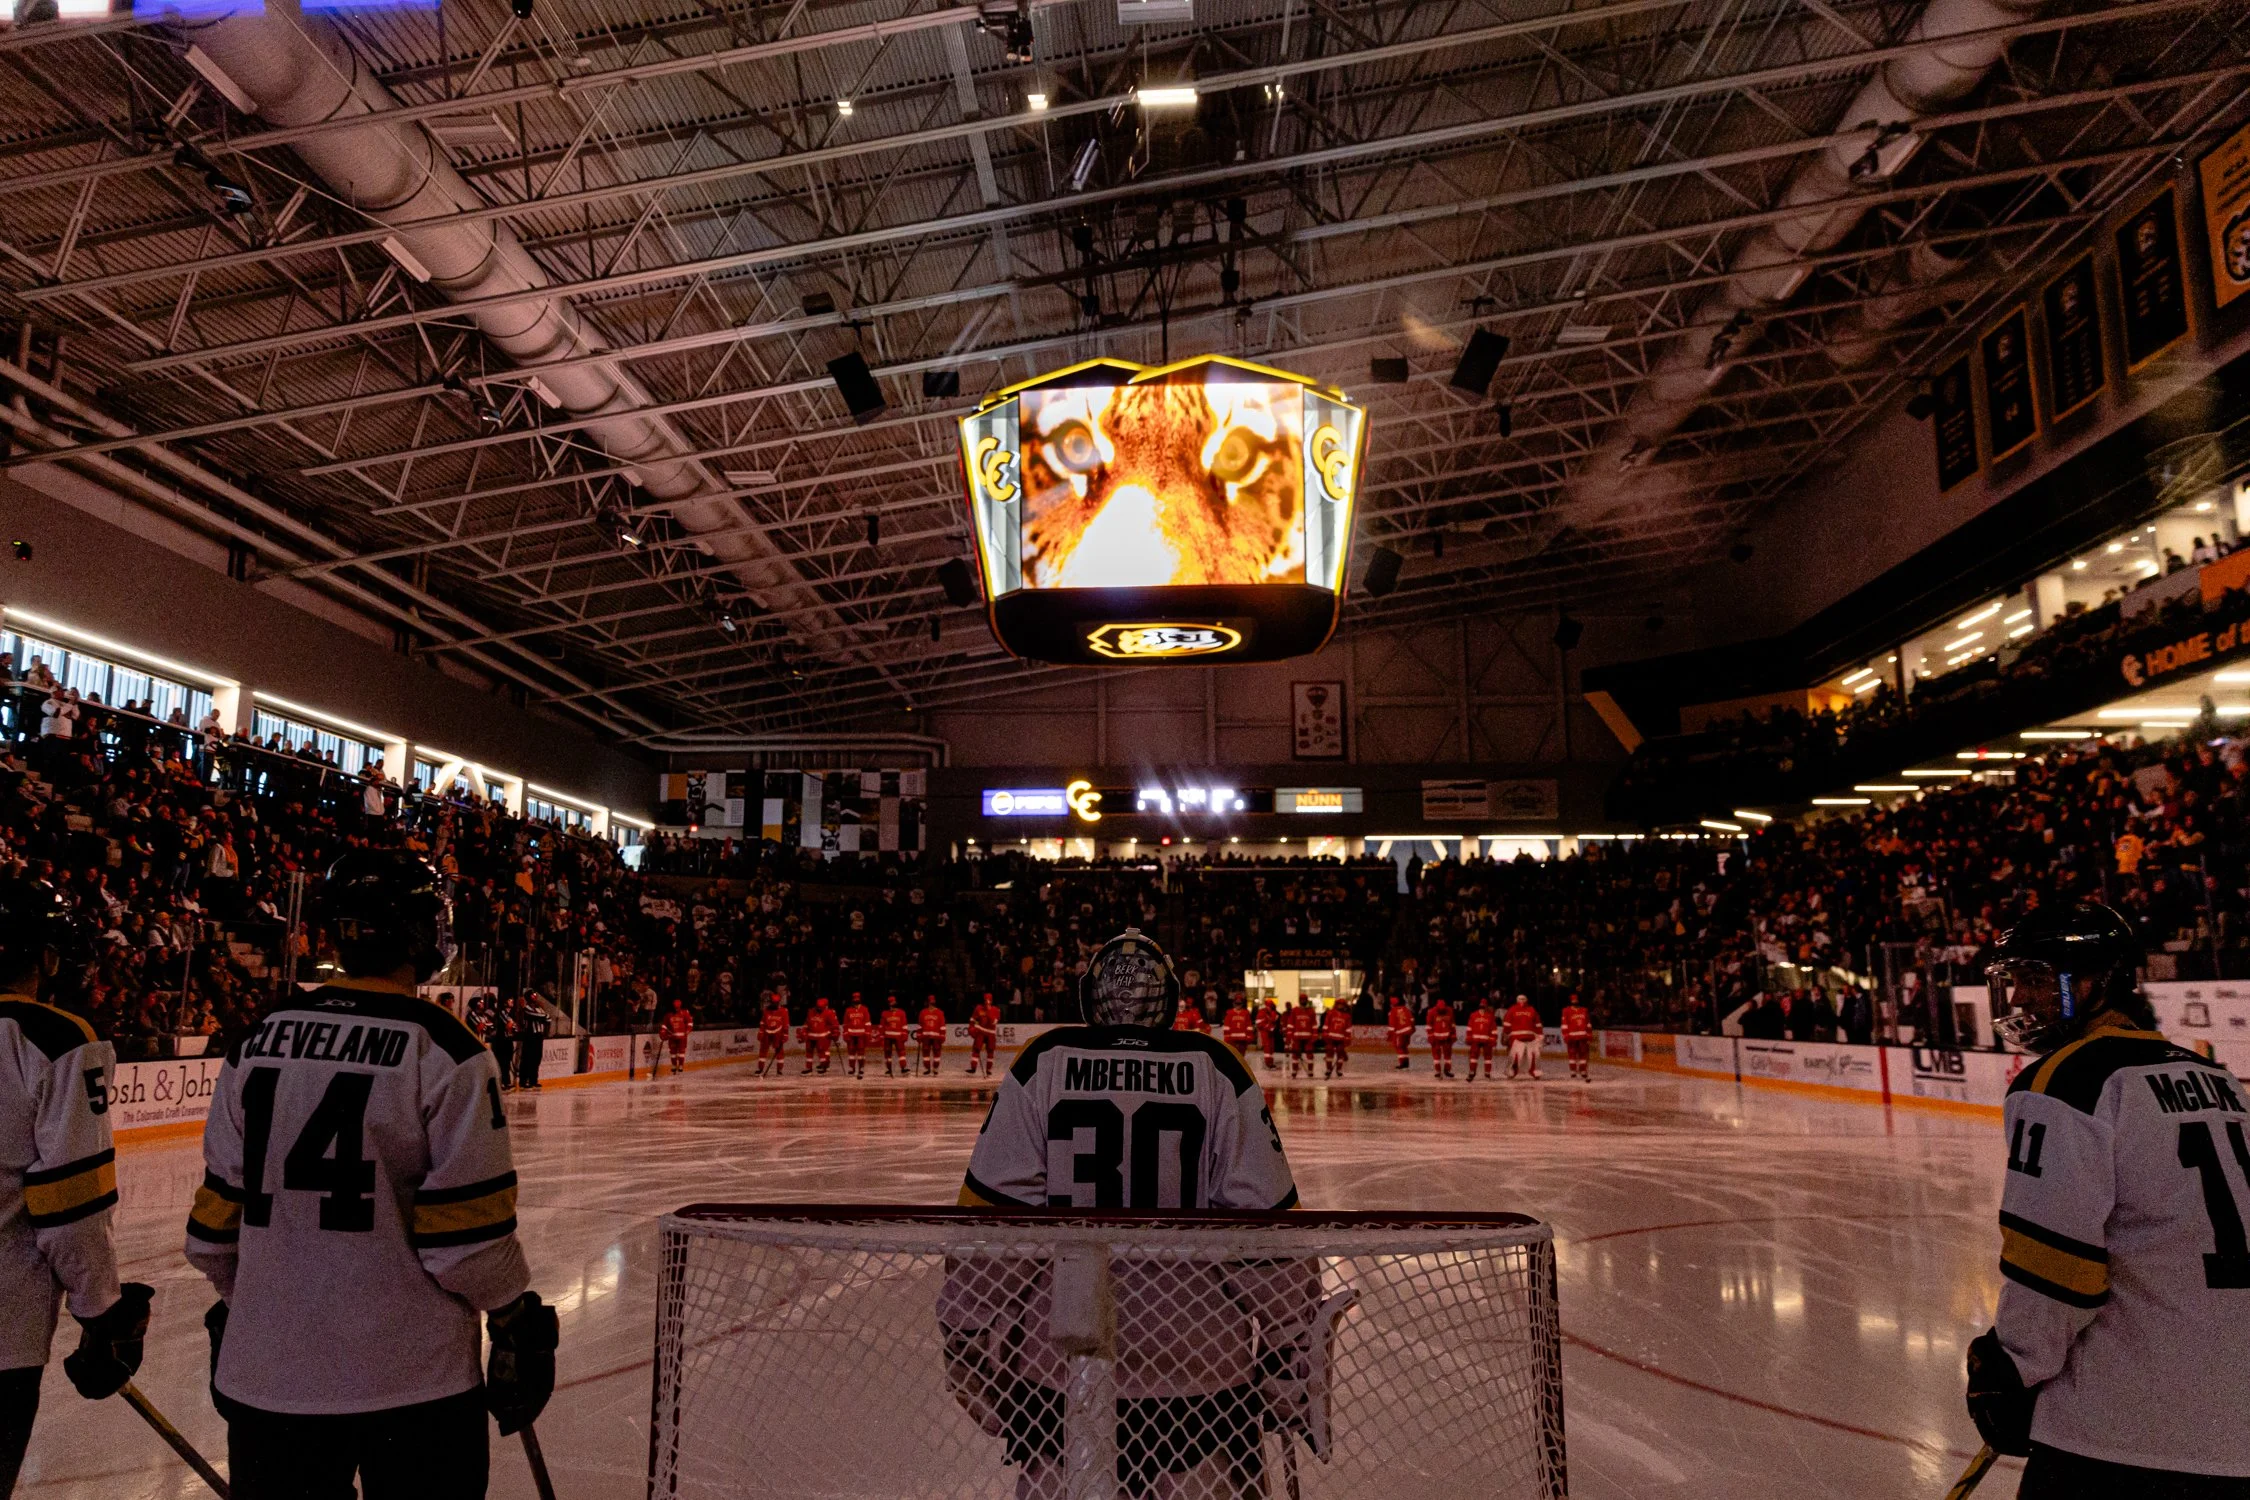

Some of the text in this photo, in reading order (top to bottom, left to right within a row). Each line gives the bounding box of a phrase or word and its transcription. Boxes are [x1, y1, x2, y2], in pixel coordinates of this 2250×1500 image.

[2144, 631, 2213, 676] HOME
[2216, 622, 2237, 652] of
[1296, 794, 1342, 806] NUNN
[244, 1019, 410, 1067] CLEVELAND
[83, 1066, 108, 1115] 5
[109, 1062, 219, 1105] osh & Joh
[1065, 1057, 1195, 1095] MBEREKO
[242, 1066, 376, 1232] 14
[1047, 1099, 1207, 1209] 30
[2008, 1118, 2047, 1178] 11
